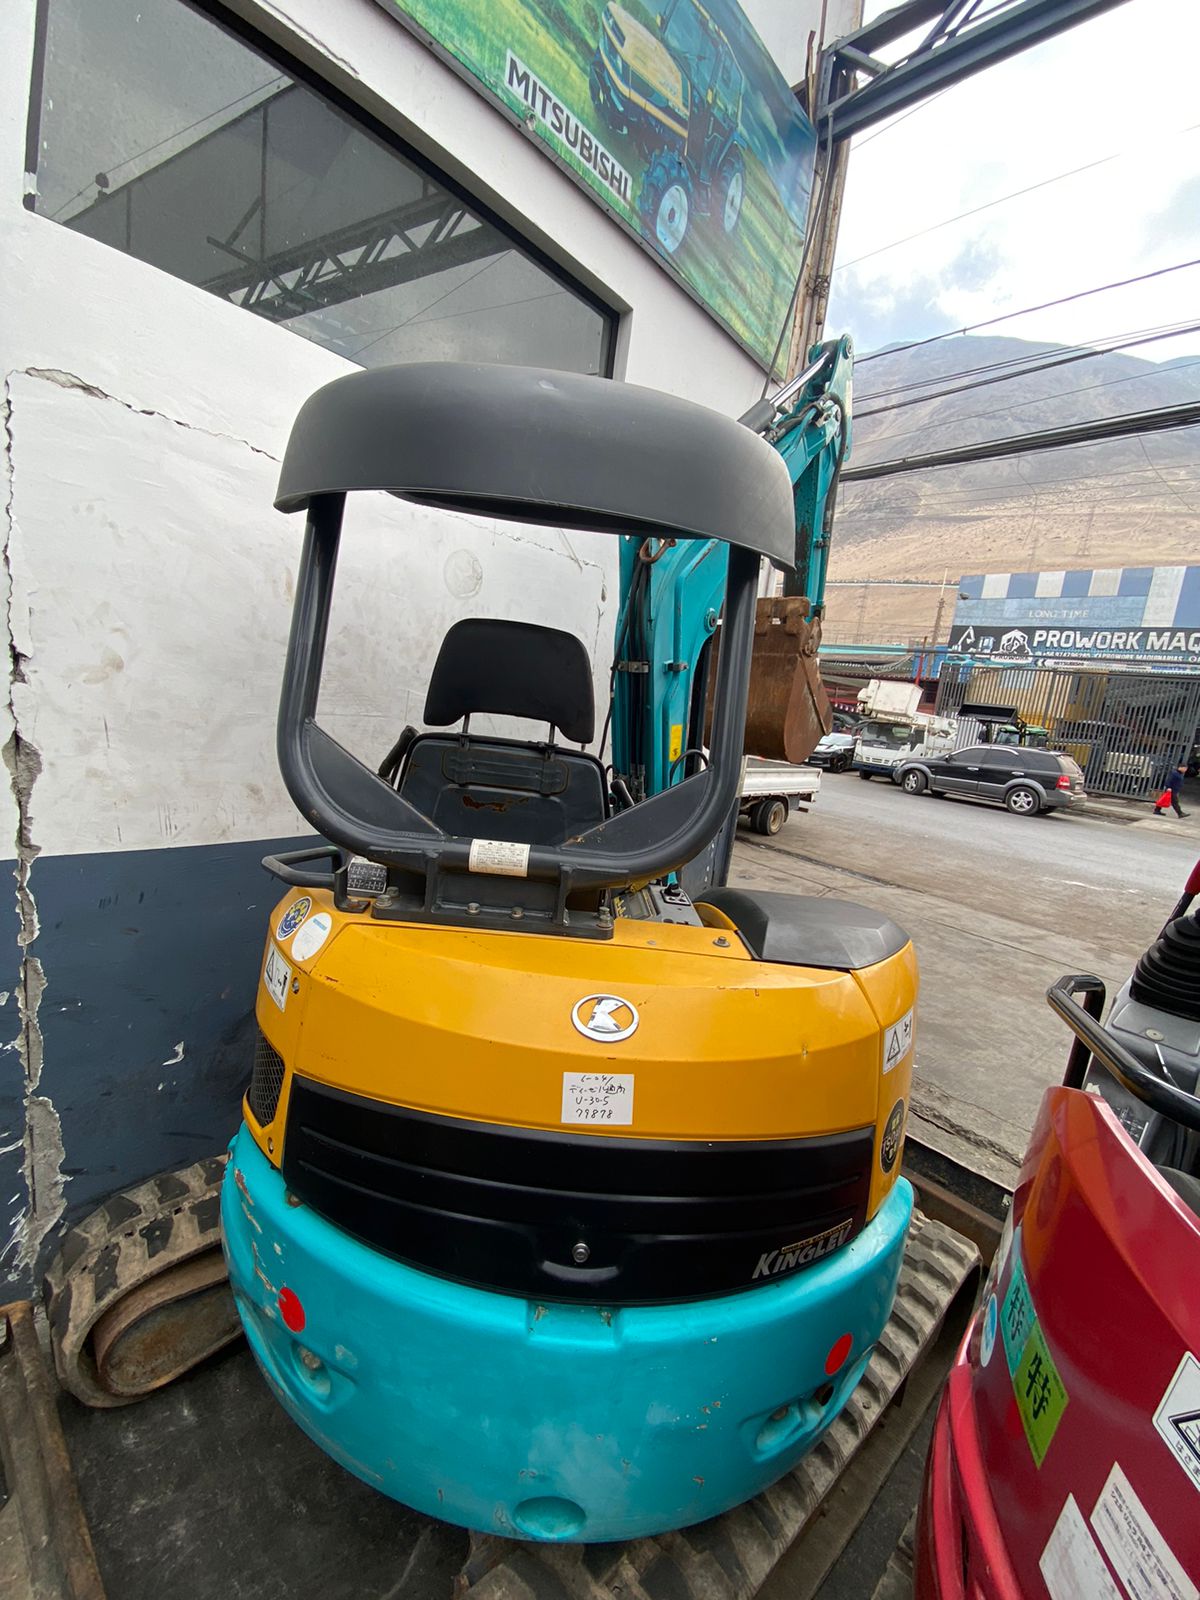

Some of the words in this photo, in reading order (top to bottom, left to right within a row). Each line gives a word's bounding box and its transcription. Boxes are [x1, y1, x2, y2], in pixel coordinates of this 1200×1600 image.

[508, 57, 629, 201] MITSUBISHI
[1028, 609, 1057, 619] LONG
[1063, 609, 1090, 619] TIME
[1033, 629, 1143, 650] PROWORK
[575, 1108, 614, 1119] 79878
[751, 1224, 852, 1280] KINGLEV
[1026, 1351, 1052, 1421] 特
